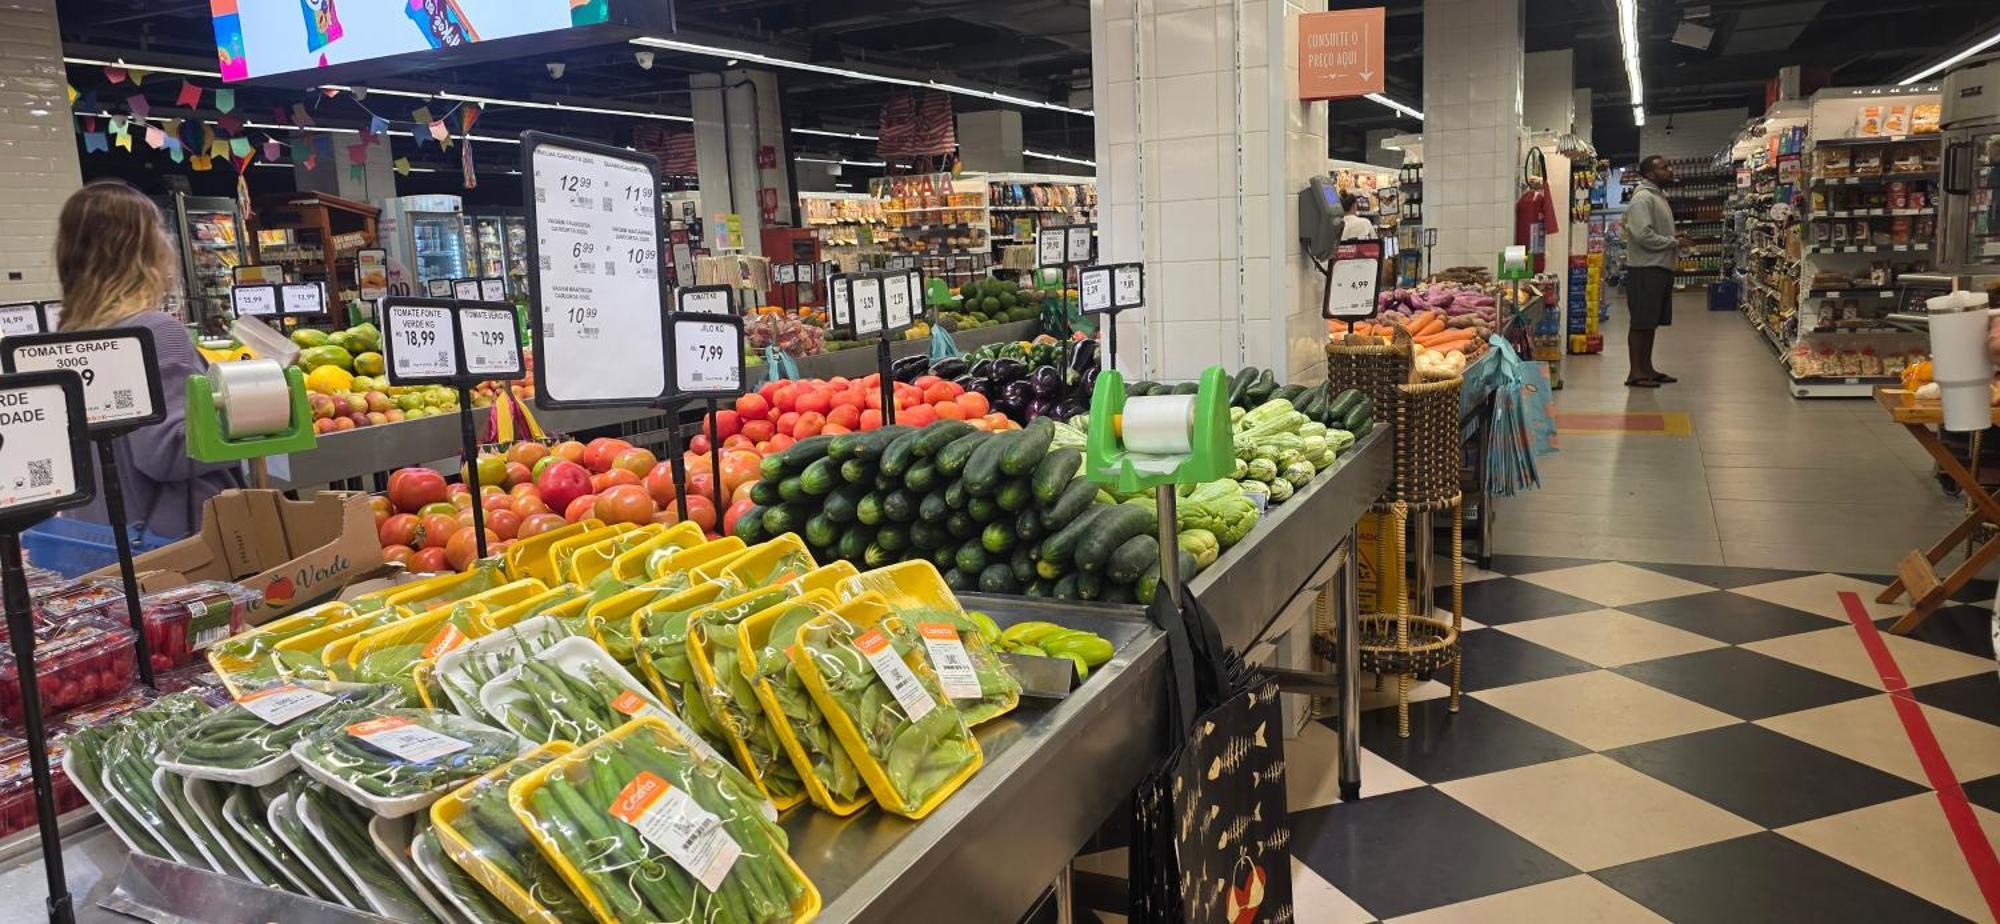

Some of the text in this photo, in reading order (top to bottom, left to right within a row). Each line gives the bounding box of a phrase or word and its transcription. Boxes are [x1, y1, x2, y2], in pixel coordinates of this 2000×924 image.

[1307, 31, 1358, 48] CONSULTE O
[1308, 50, 1357, 69] PREÇO AQUI
[393, 308, 442, 318] TOMATE FONTE
[465, 310, 488, 319] TOMATE
[402, 319, 435, 329] VERDE KG
[715, 324, 725, 333] KG
[405, 330, 435, 348] 18,99
[480, 331, 504, 347] 12,99
[20, 341, 119, 358] TOMATE GRAPE
[699, 345, 724, 362] 7,99
[57, 356, 89, 369] 300G
[297, 554, 349, 588] Verde
